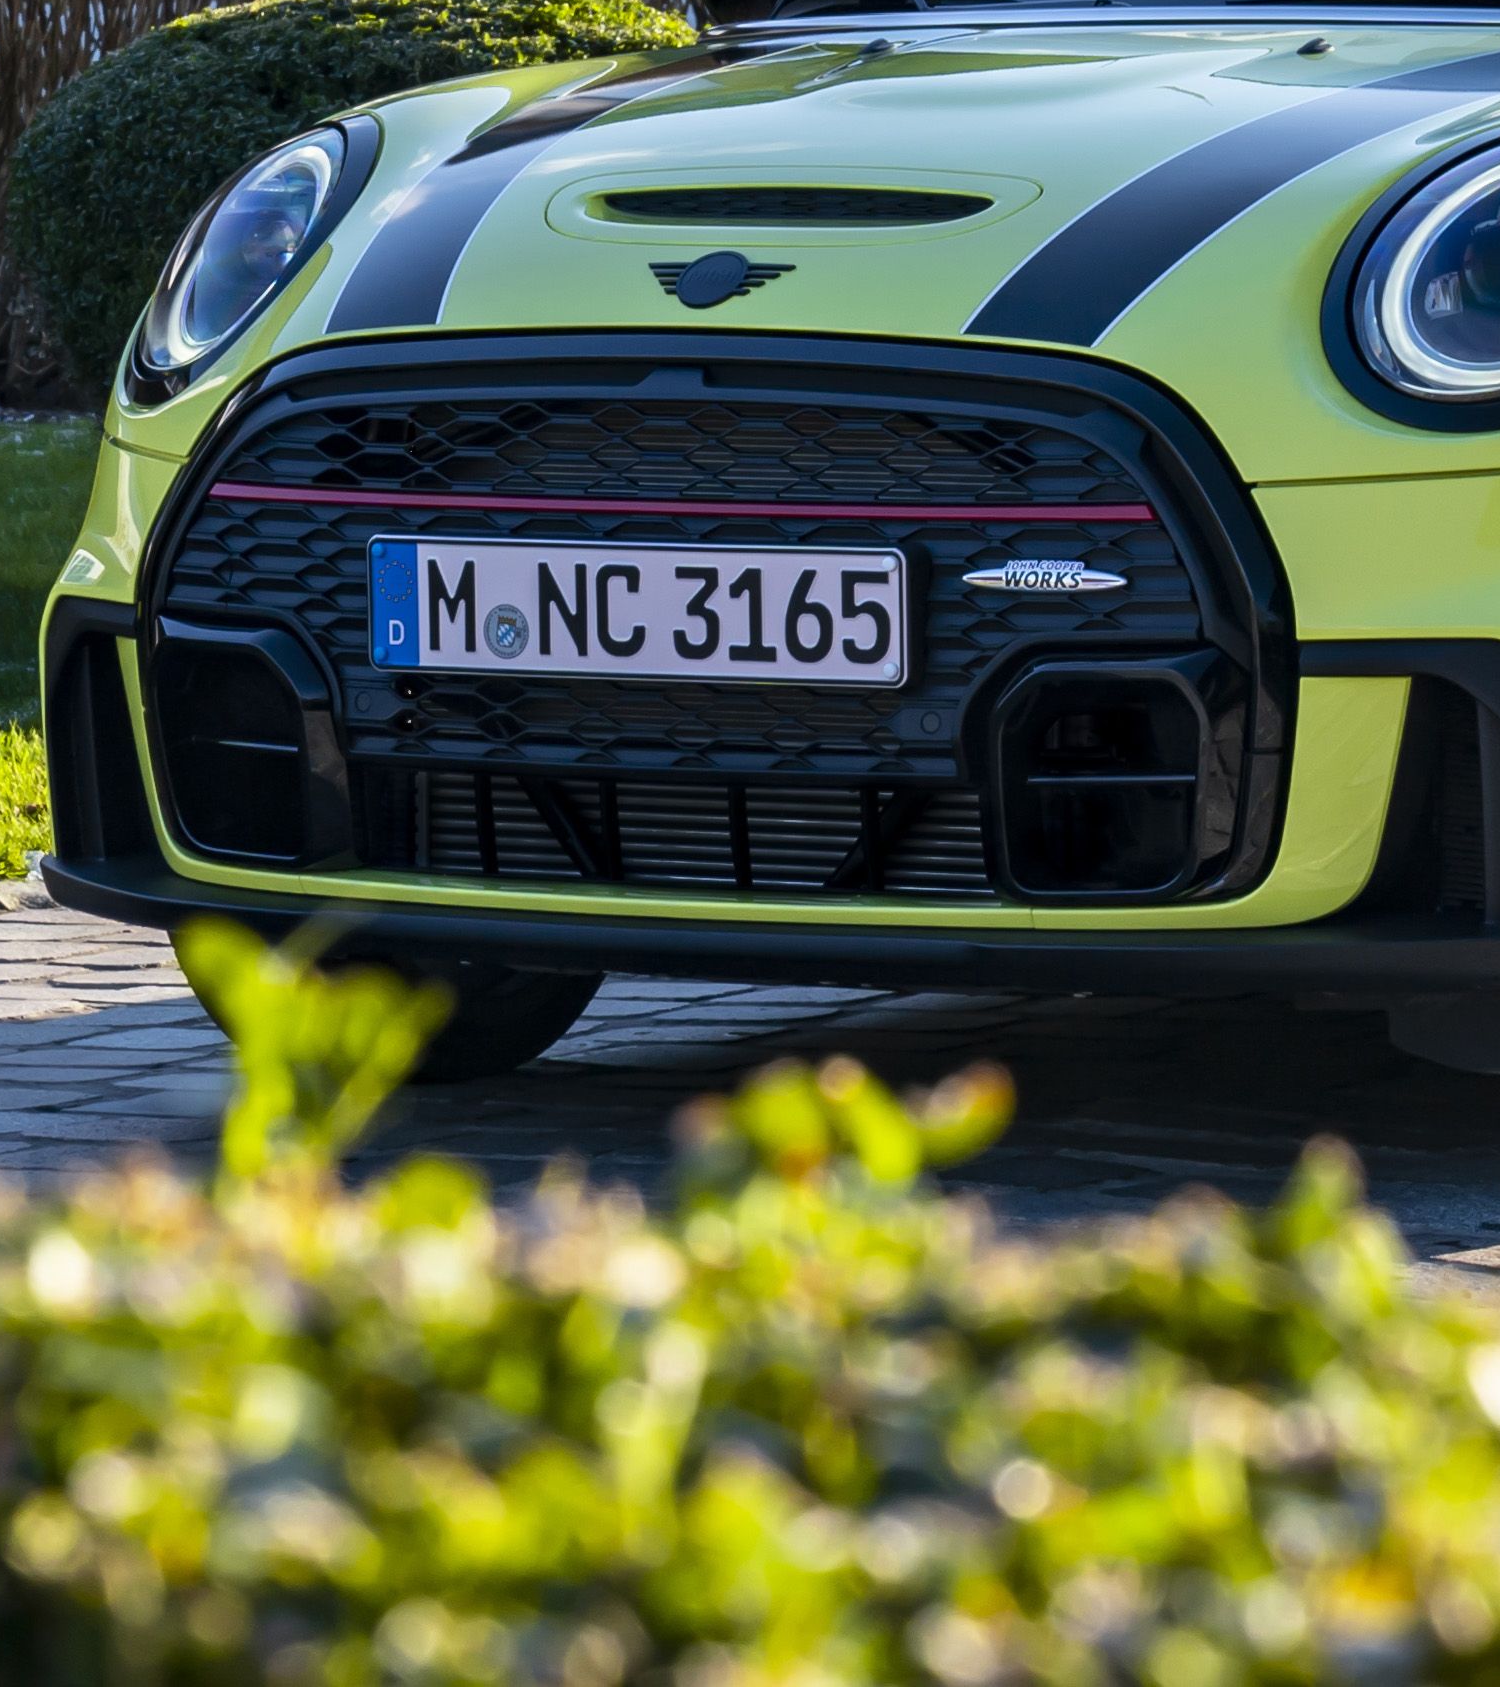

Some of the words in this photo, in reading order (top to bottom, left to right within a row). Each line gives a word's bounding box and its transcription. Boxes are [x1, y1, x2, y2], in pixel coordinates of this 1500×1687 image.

[1007, 561, 1037, 570] JOHN
[1040, 562, 1084, 571] COOPER
[1005, 571, 1082, 588] WORKS
[427, 559, 477, 653] M
[537, 562, 646, 659] NC
[672, 565, 892, 665] 3165
[388, 619, 405, 646] D
